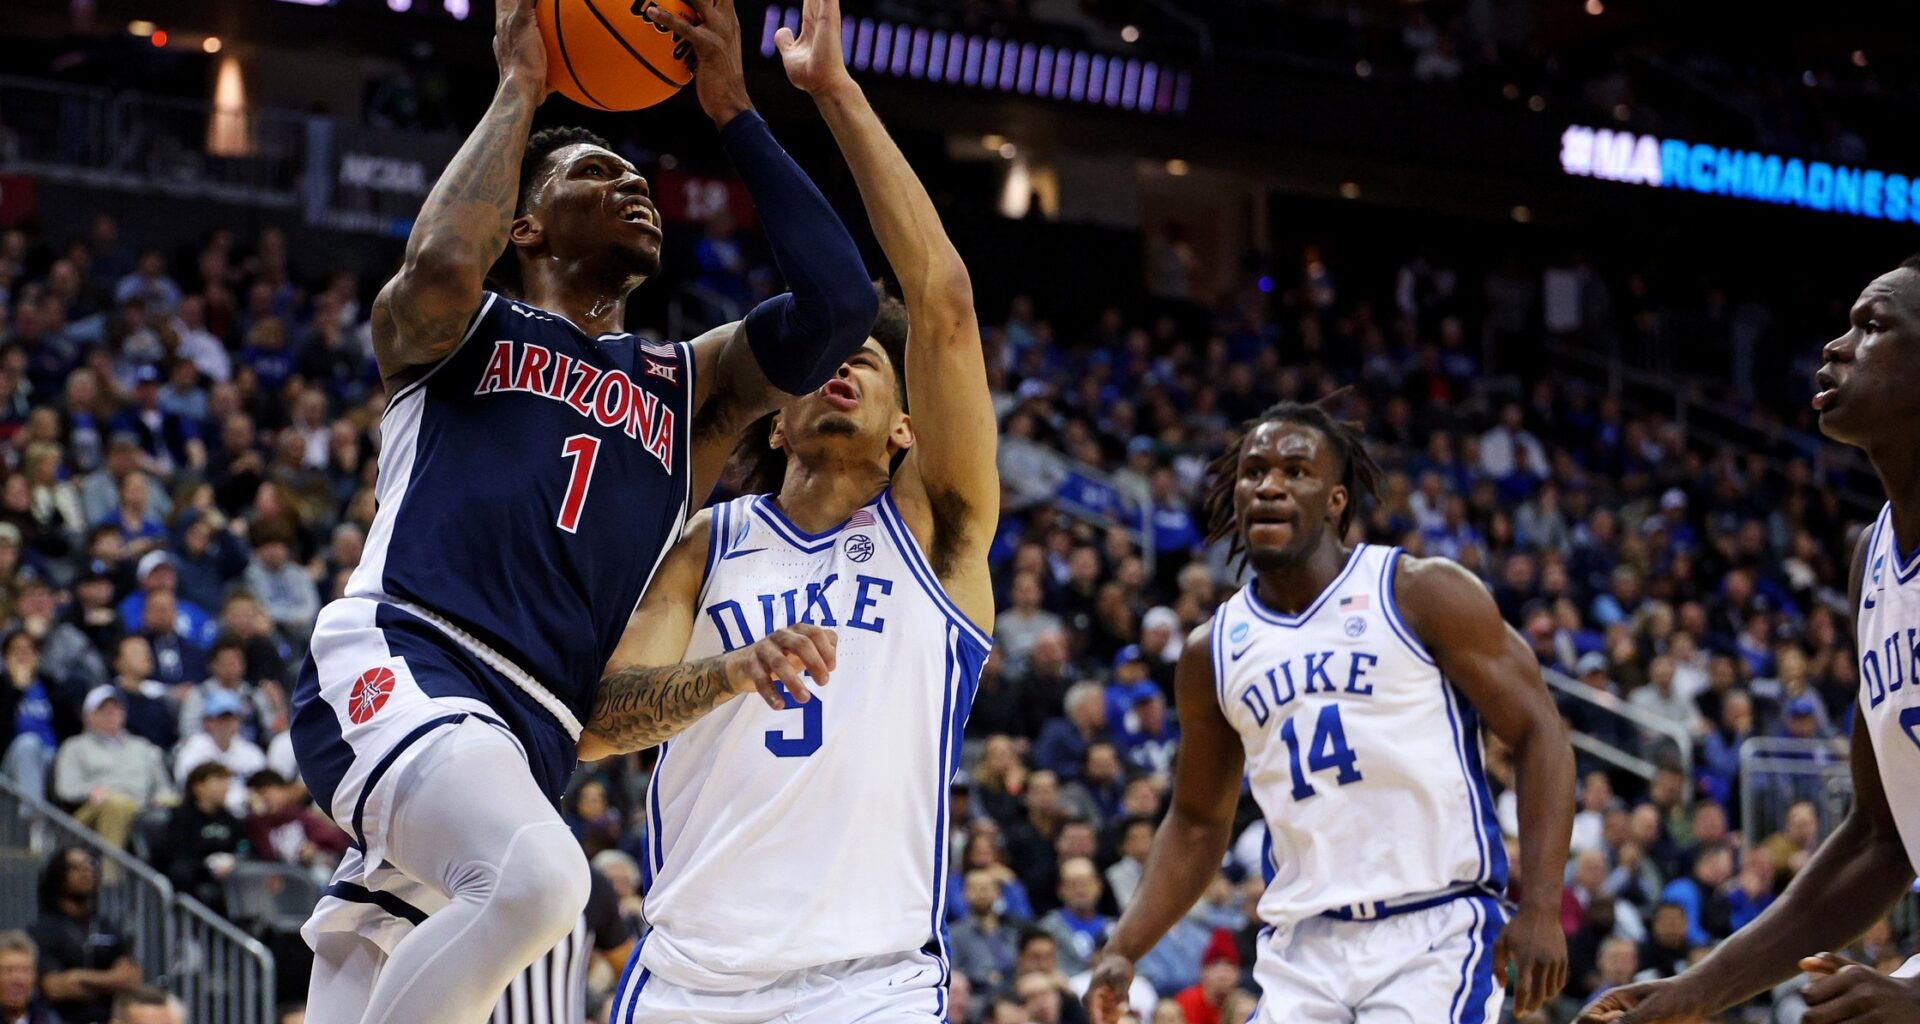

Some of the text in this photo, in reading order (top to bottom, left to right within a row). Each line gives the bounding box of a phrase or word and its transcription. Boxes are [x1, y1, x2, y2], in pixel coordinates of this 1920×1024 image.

[474, 341, 675, 476] ARIZONA
[556, 433, 601, 534] 1
[706, 573, 893, 654] DUKE
[597, 666, 711, 731] Sacrifice
[1241, 651, 1378, 728] DUKE
[1280, 703, 1363, 802] 14
